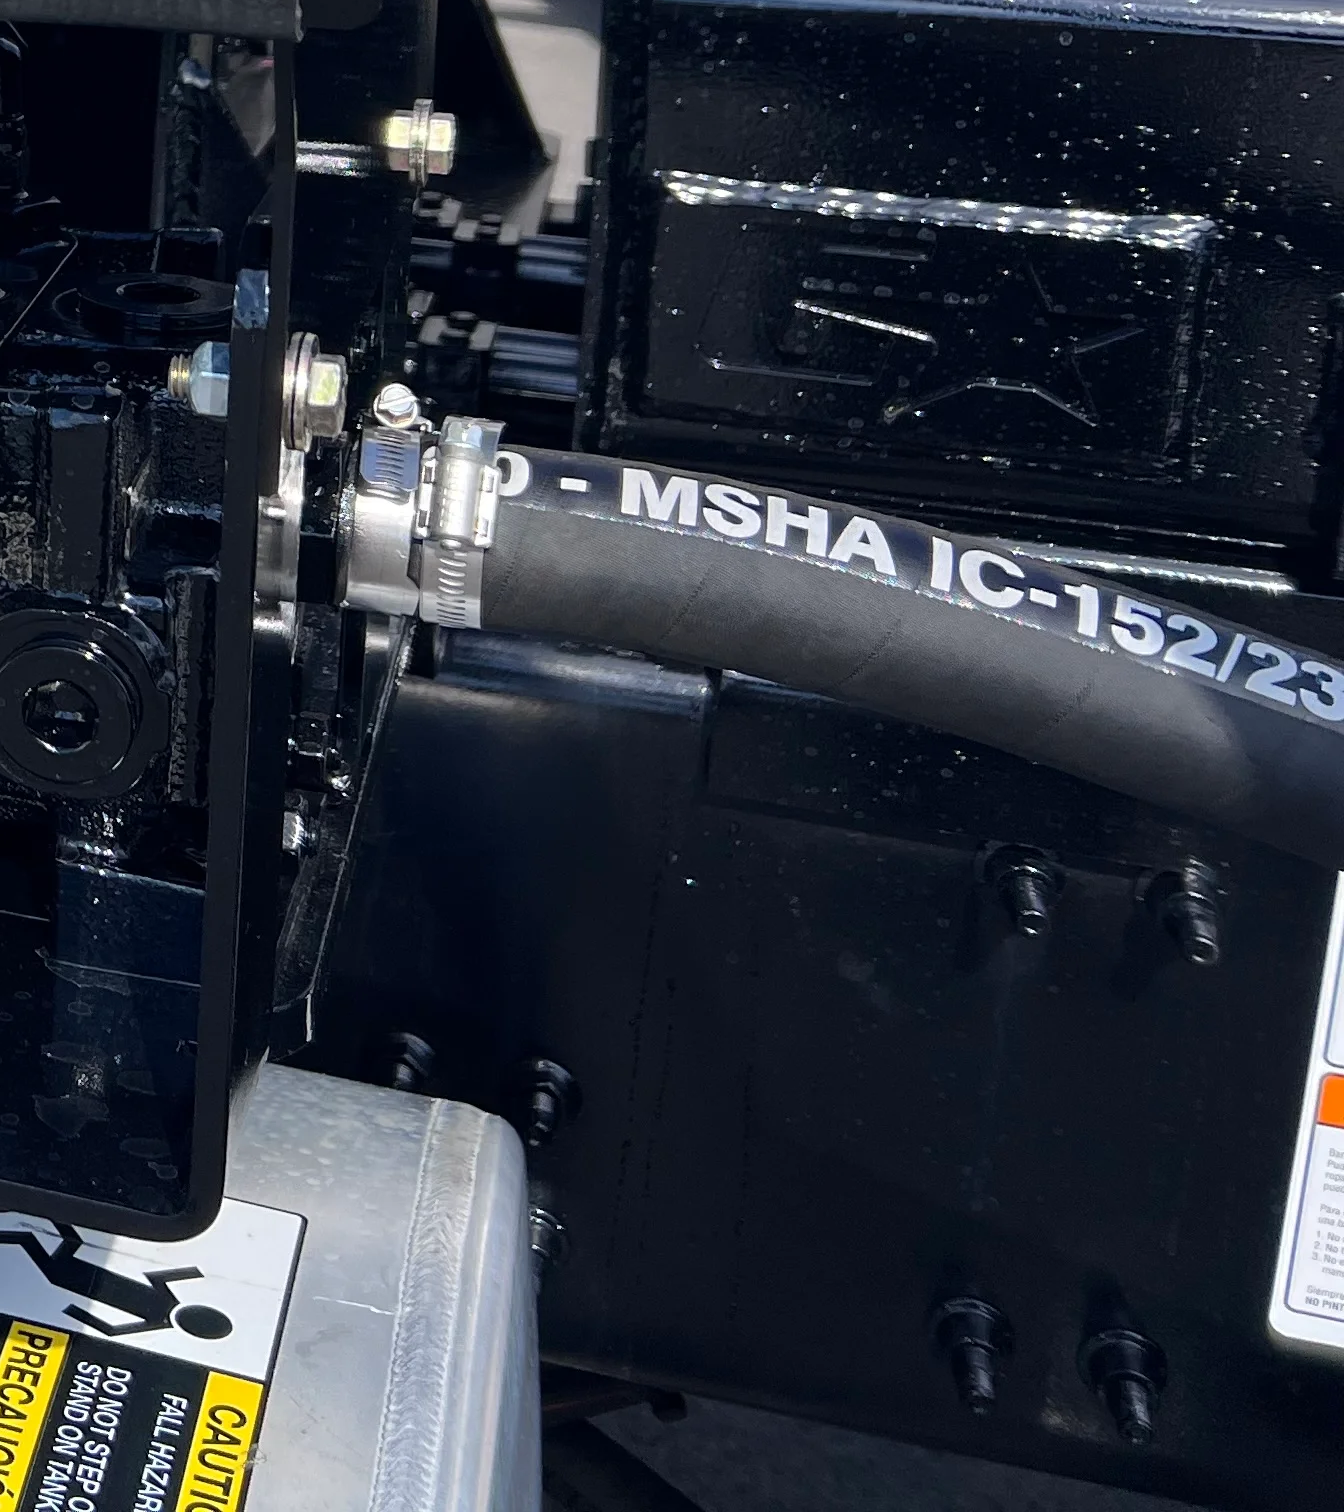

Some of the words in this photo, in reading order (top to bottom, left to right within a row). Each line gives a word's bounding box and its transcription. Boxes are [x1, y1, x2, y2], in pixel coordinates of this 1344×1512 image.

[621, 467, 897, 576] MSHA
[929, 536, 1344, 721] IC-152/23
[63, 1361, 103, 1422] STAND
[101, 1366, 133, 1396] DO
[90, 1396, 124, 1440] NOT
[153, 1393, 188, 1437] FALL
[52, 1424, 84, 1457] ON
[75, 1440, 111, 1495] STEP
[132, 1441, 176, 1512] HAZAR
